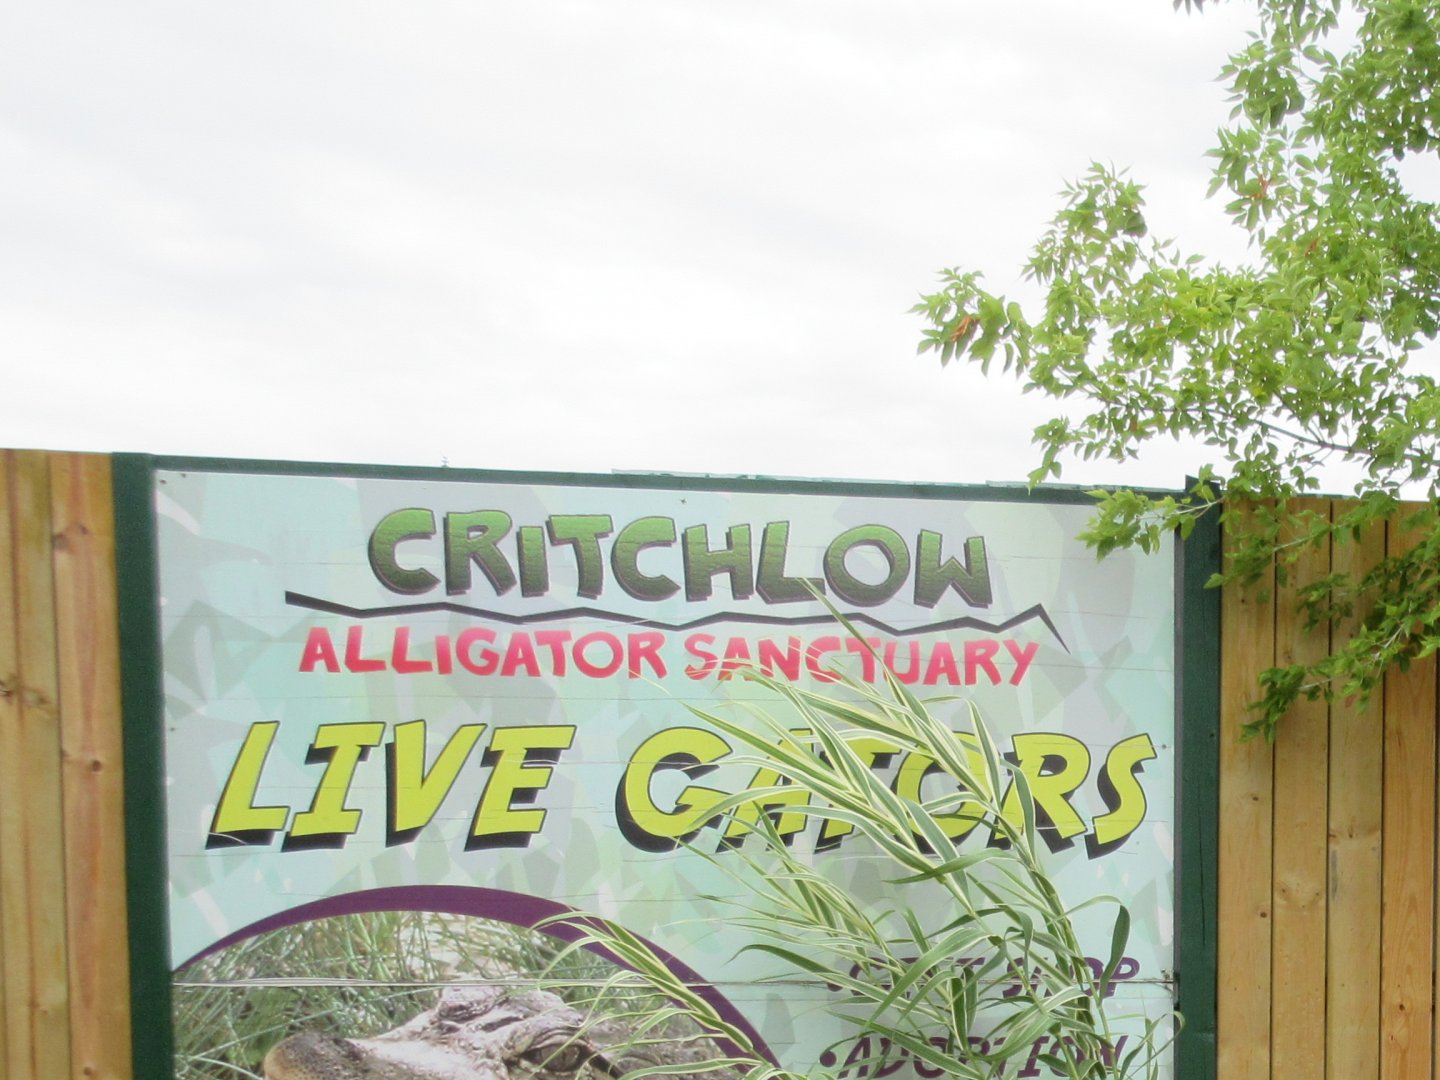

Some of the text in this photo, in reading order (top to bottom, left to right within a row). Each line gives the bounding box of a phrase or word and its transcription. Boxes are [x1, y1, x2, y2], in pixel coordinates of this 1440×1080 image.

[368, 507, 993, 607] CRITCHLOW
[298, 625, 1039, 686] ALLIGATOR SANCTUARY
[205, 719, 1157, 860] LIVE GATORS
[1000, 955, 1142, 1000] SOP
[836, 1033, 1131, 1080] ADOPION
